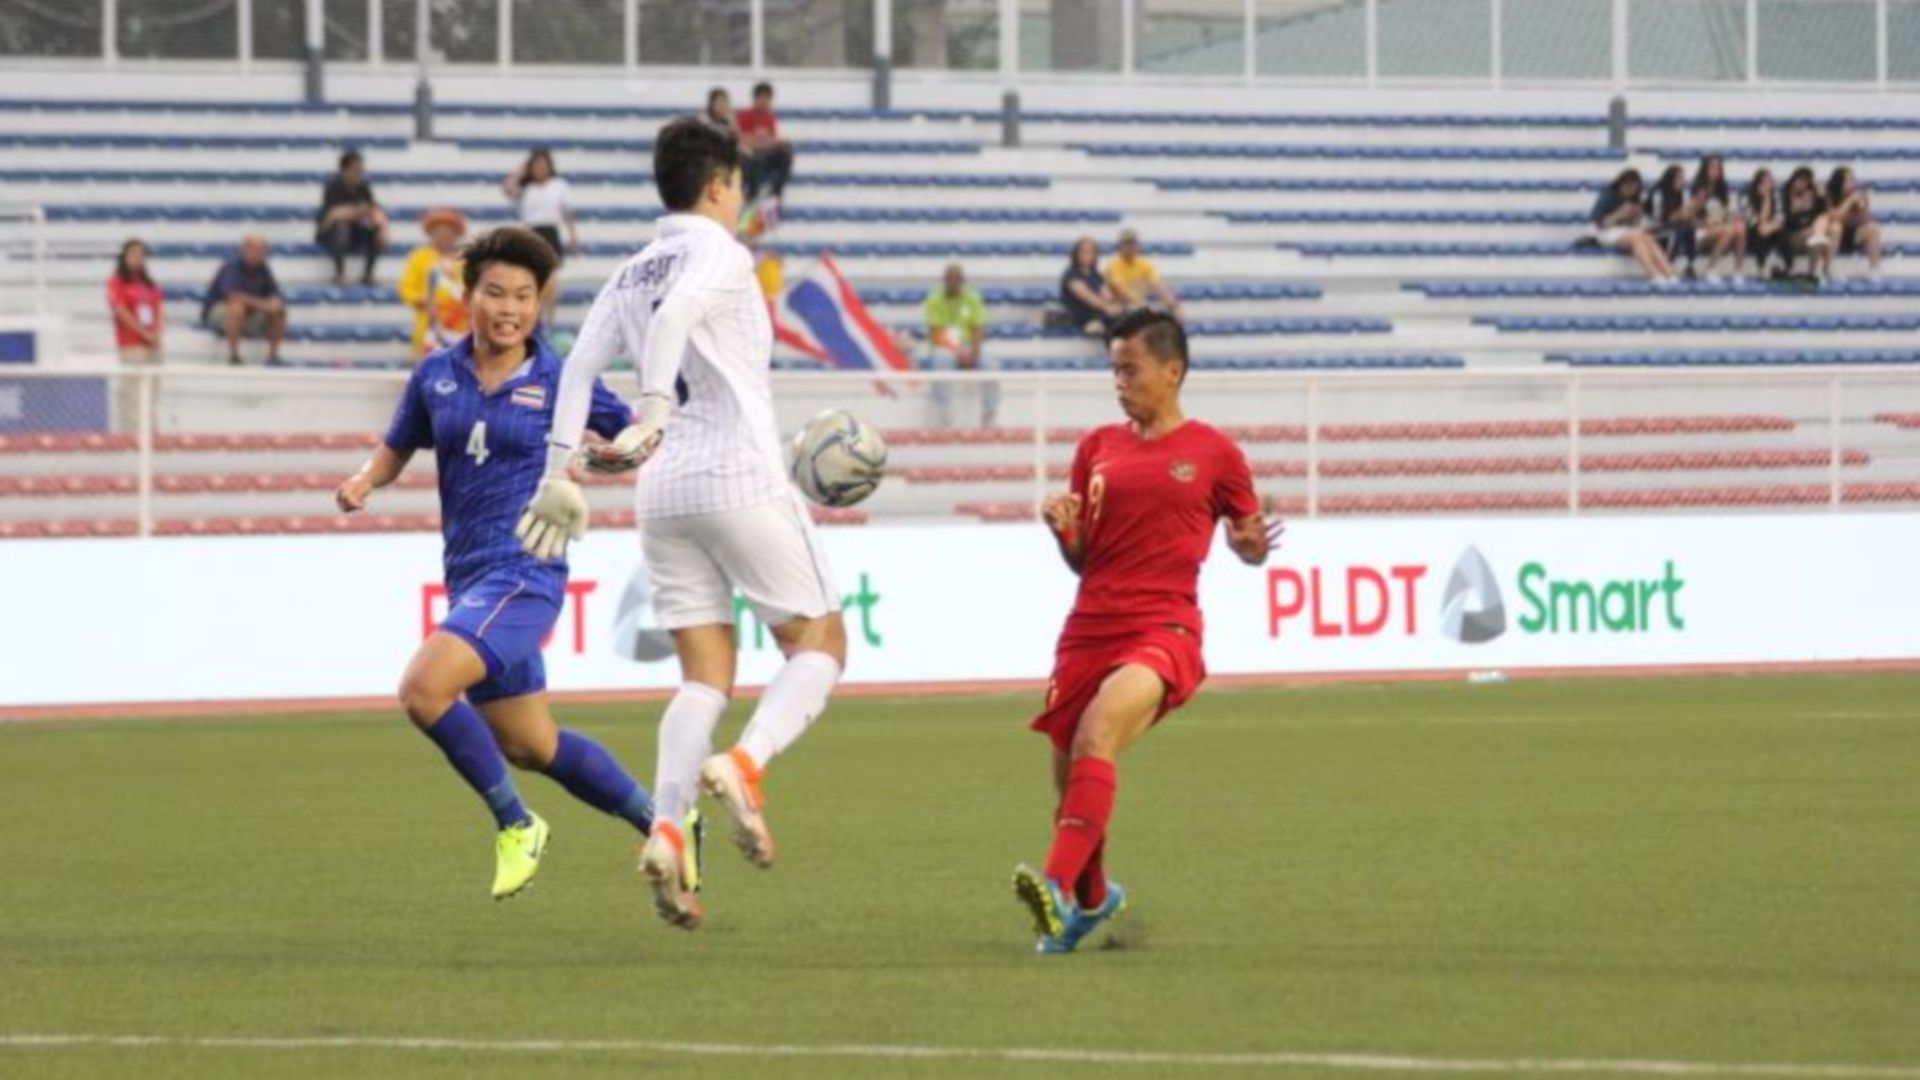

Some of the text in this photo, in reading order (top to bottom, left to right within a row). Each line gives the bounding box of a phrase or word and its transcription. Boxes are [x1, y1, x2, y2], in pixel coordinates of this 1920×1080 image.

[466, 421, 490, 465] 4
[1088, 474, 1104, 520] 9
[1267, 560, 1684, 637] PLDT Smart
